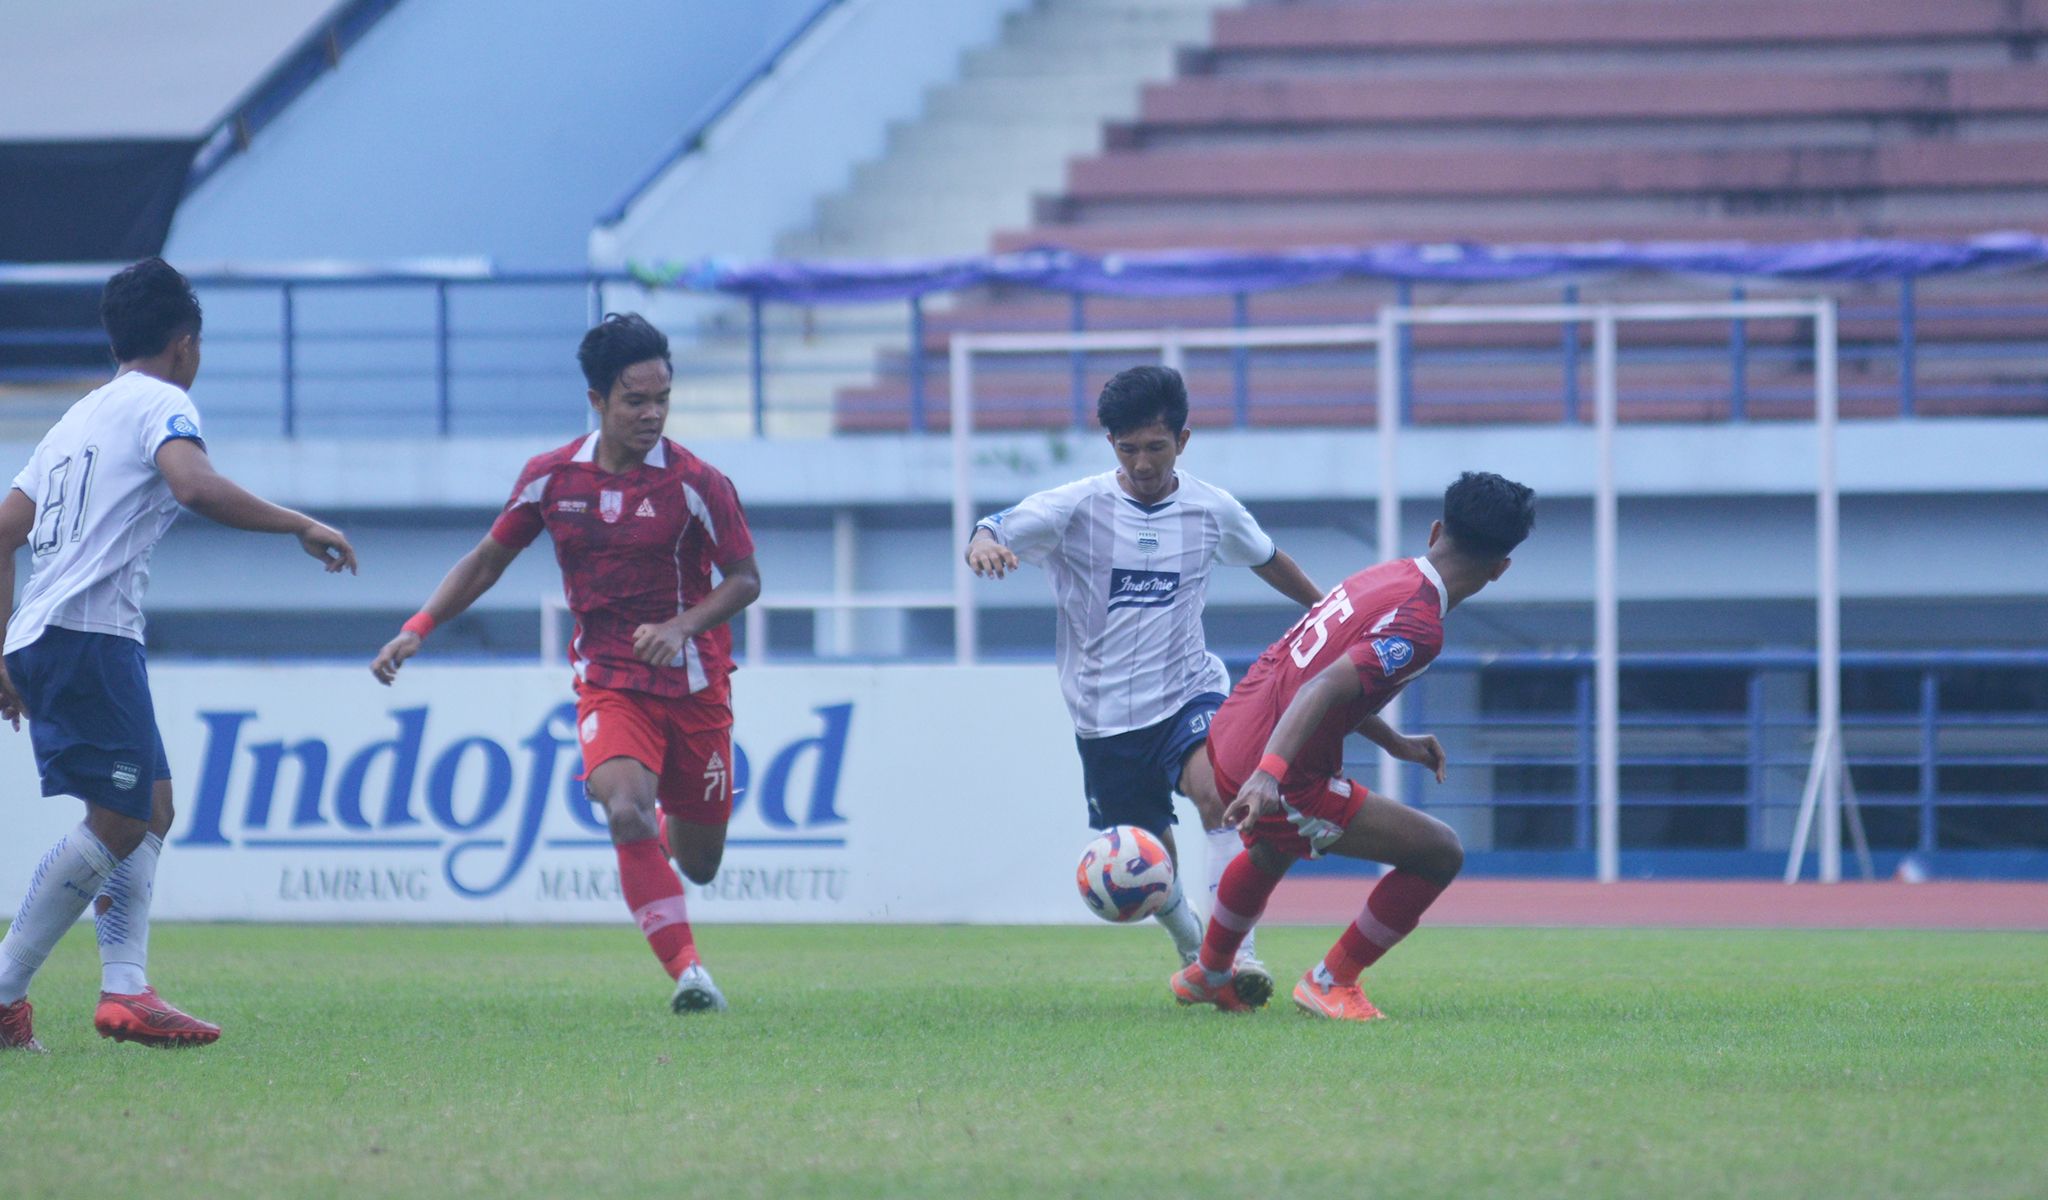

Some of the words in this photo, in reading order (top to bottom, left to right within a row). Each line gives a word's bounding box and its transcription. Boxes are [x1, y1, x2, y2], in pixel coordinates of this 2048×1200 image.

[33, 446, 99, 557] 81
[169, 702, 854, 898] Indofd
[703, 770, 726, 801] 71
[279, 868, 431, 900] LAMBANG
